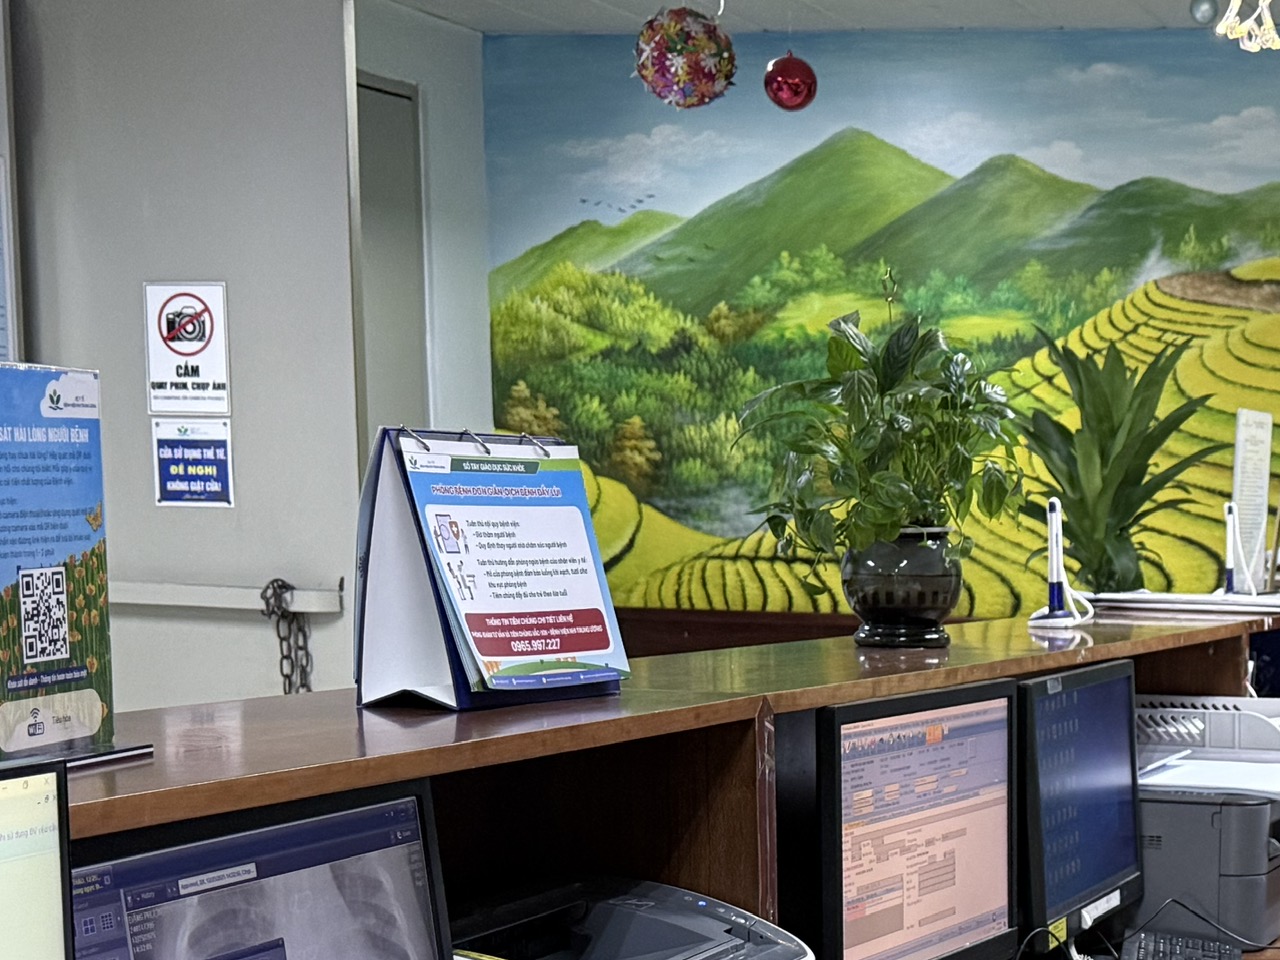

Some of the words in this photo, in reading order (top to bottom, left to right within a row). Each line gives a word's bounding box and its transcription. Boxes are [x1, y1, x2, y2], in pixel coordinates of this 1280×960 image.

[176, 360, 200, 378] CẤM
[70, 425, 89, 448] BỆNH
[187, 465, 217, 478] NGHỊ
